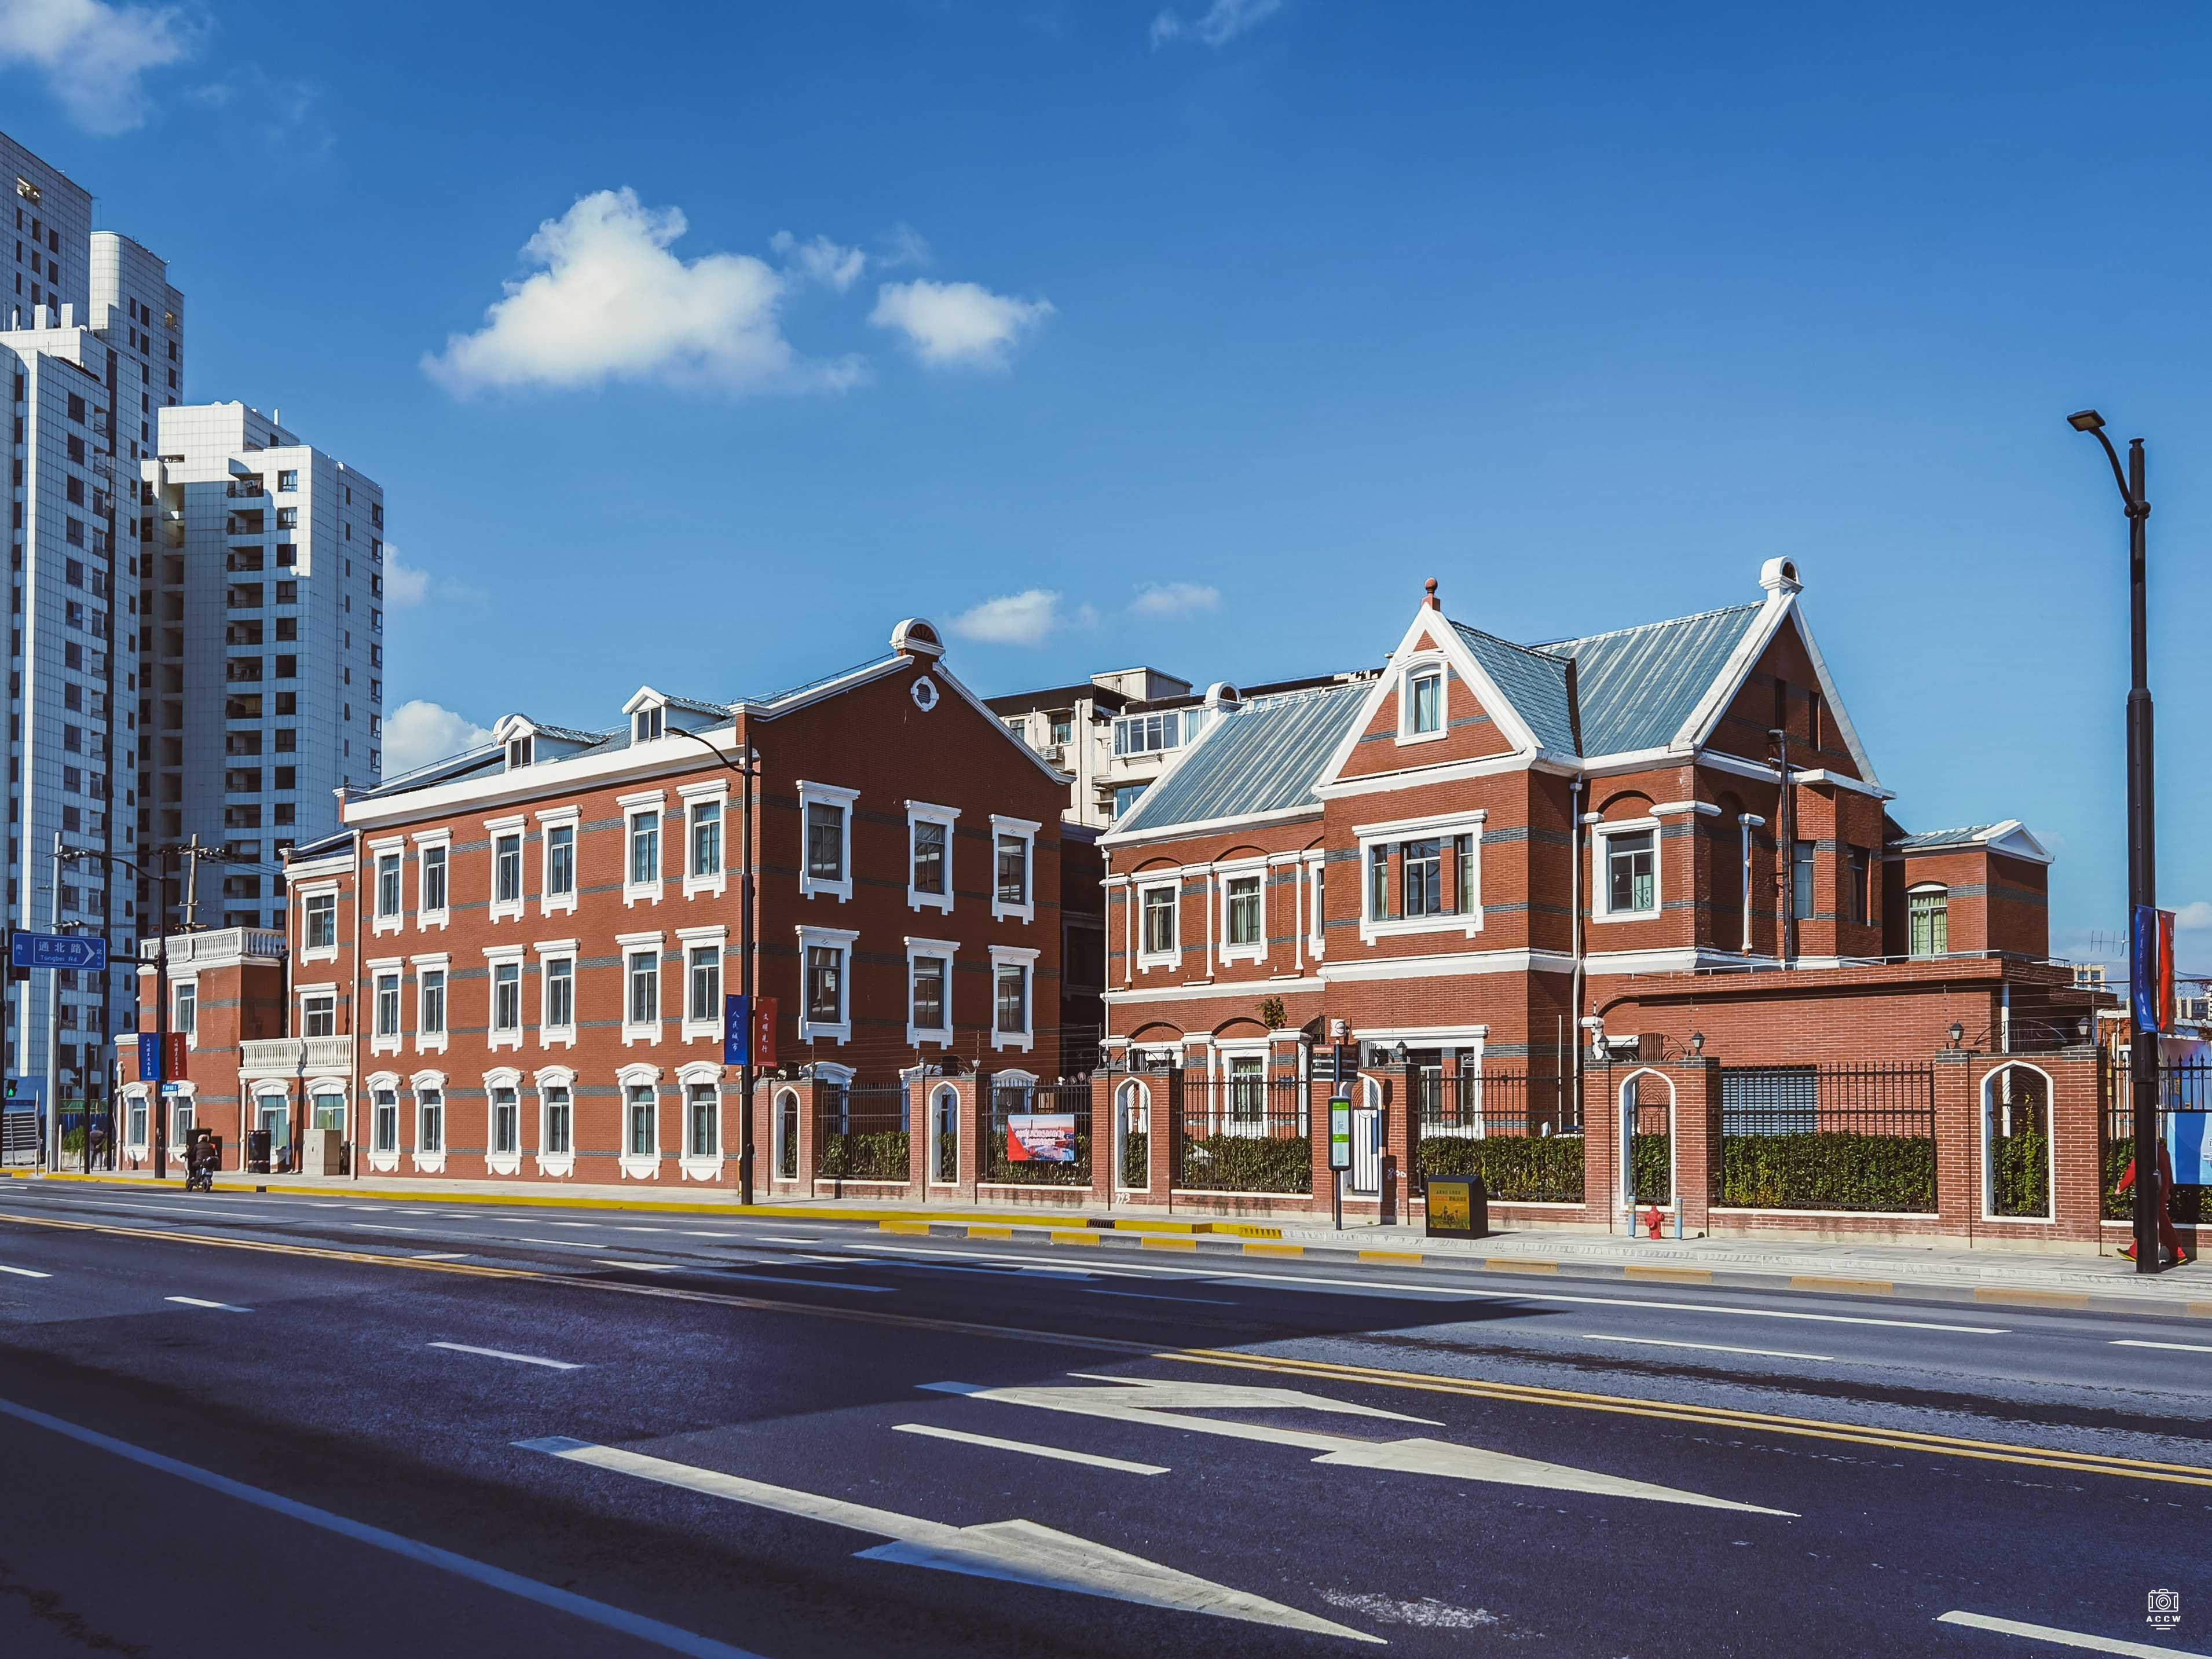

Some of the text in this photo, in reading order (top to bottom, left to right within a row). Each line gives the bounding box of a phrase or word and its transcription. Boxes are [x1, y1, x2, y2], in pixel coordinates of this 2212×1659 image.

[38, 941, 81, 954] 通北路
[732, 1011, 740, 1052] 人民城市
